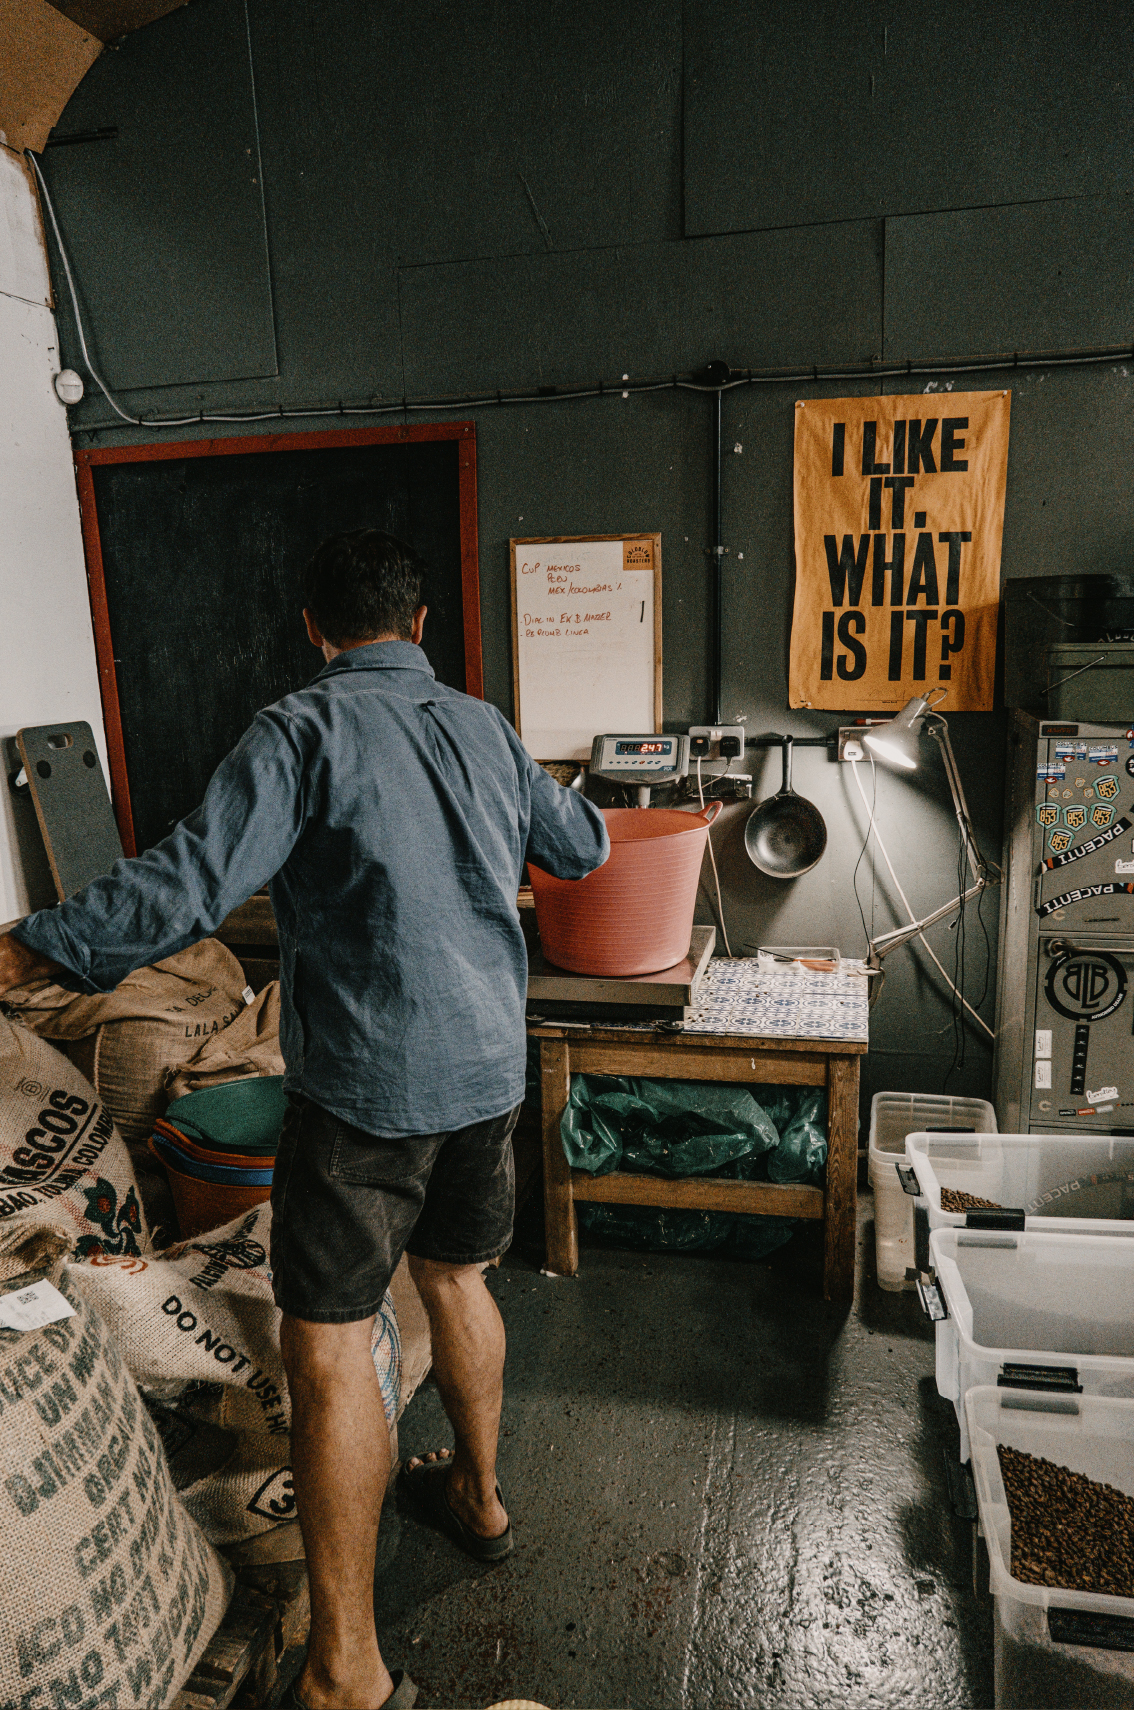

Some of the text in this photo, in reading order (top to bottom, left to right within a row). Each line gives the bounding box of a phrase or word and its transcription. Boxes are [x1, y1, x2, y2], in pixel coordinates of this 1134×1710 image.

[832, 416, 969, 477] I LIKE
[868, 476, 927, 531] IT.
[823, 531, 972, 607] WHAT
[820, 609, 966, 681] IS IT?
[1098, 781, 1117, 798] 853
[1040, 809, 1056, 825] 853
[1067, 811, 1084, 827] 853
[1092, 809, 1112, 825] 853
[1051, 834, 1070, 851] 853
[1058, 823, 1125, 865] PACENTI
[1043, 884, 1114, 914] PACENTI
[185, 1021, 219, 1037] LALA
[0, 1089, 90, 1186] ASCOS
[1028, 1180, 1080, 1213] PACENT
[161, 1295, 198, 1332] DO
[195, 1329, 251, 1373] NOT
[247, 1370, 282, 1411] USE
